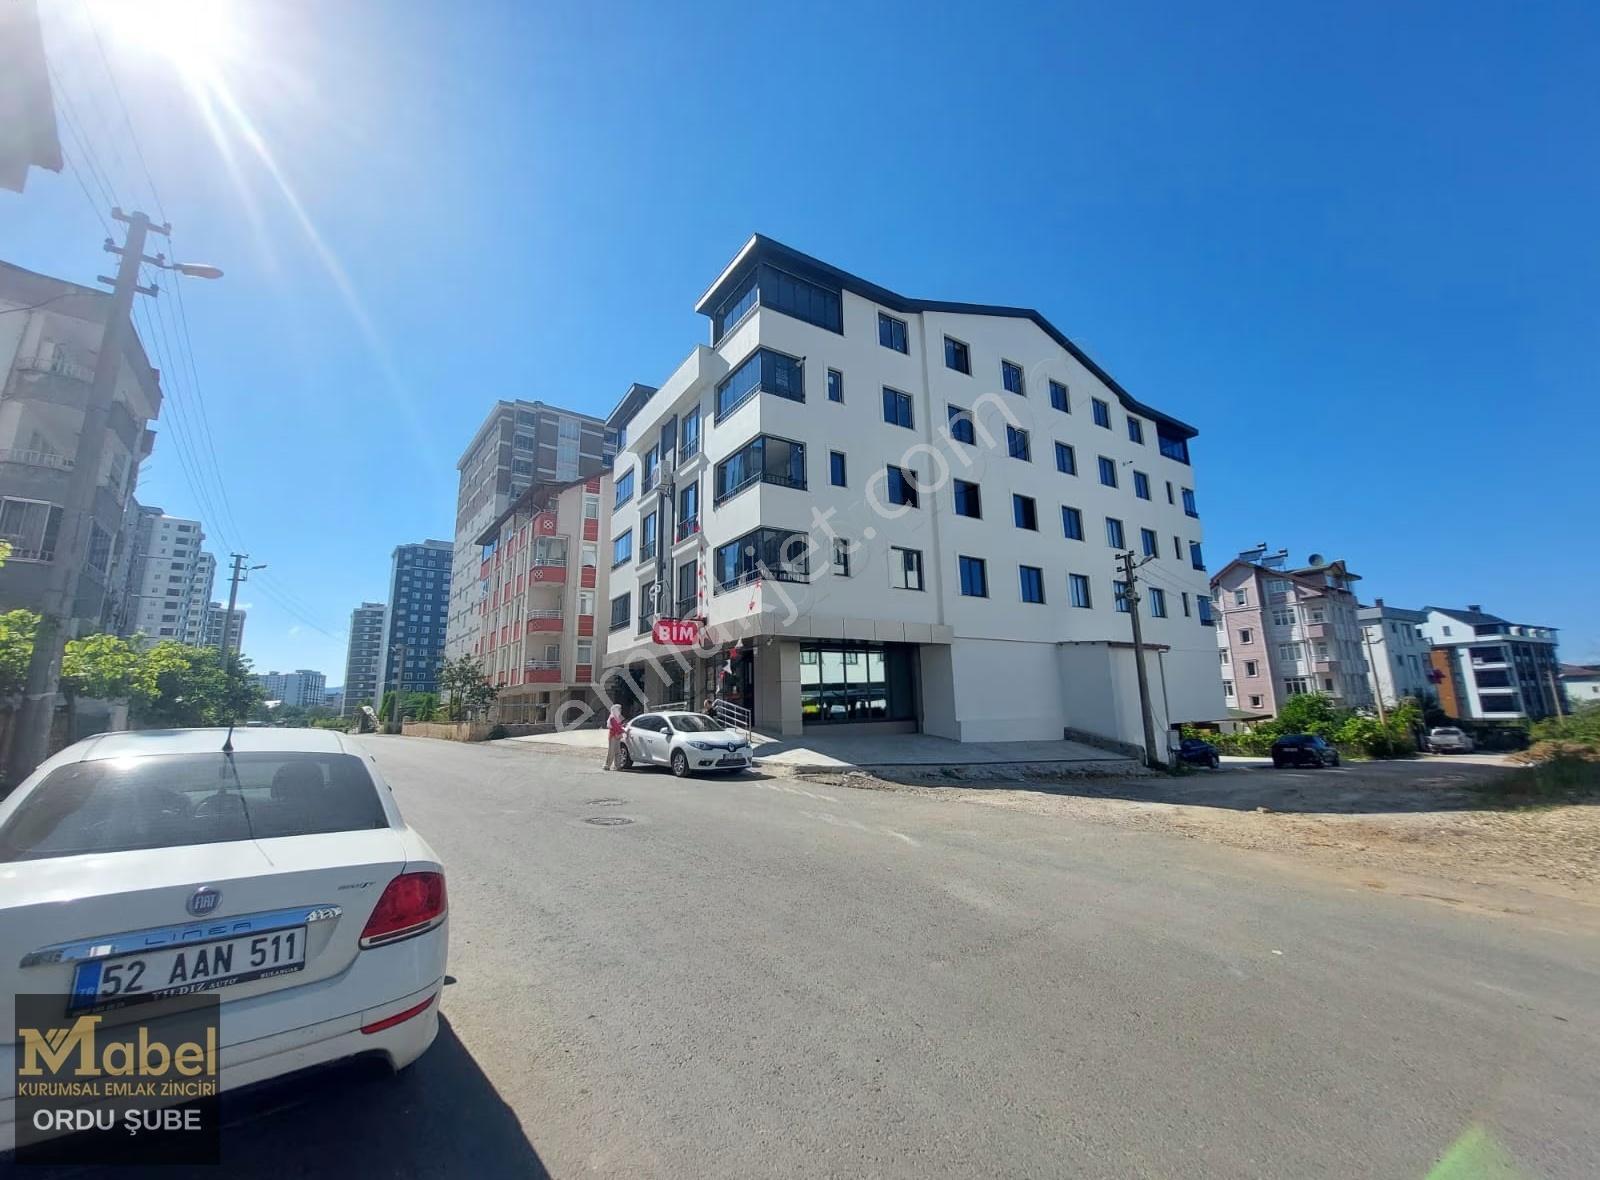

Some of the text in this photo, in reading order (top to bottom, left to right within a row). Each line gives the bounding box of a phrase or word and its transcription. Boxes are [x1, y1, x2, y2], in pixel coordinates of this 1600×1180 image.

[659, 621, 694, 641] BİM
[194, 895, 215, 909] FIAT
[101, 932, 296, 998] 52 AAN 511
